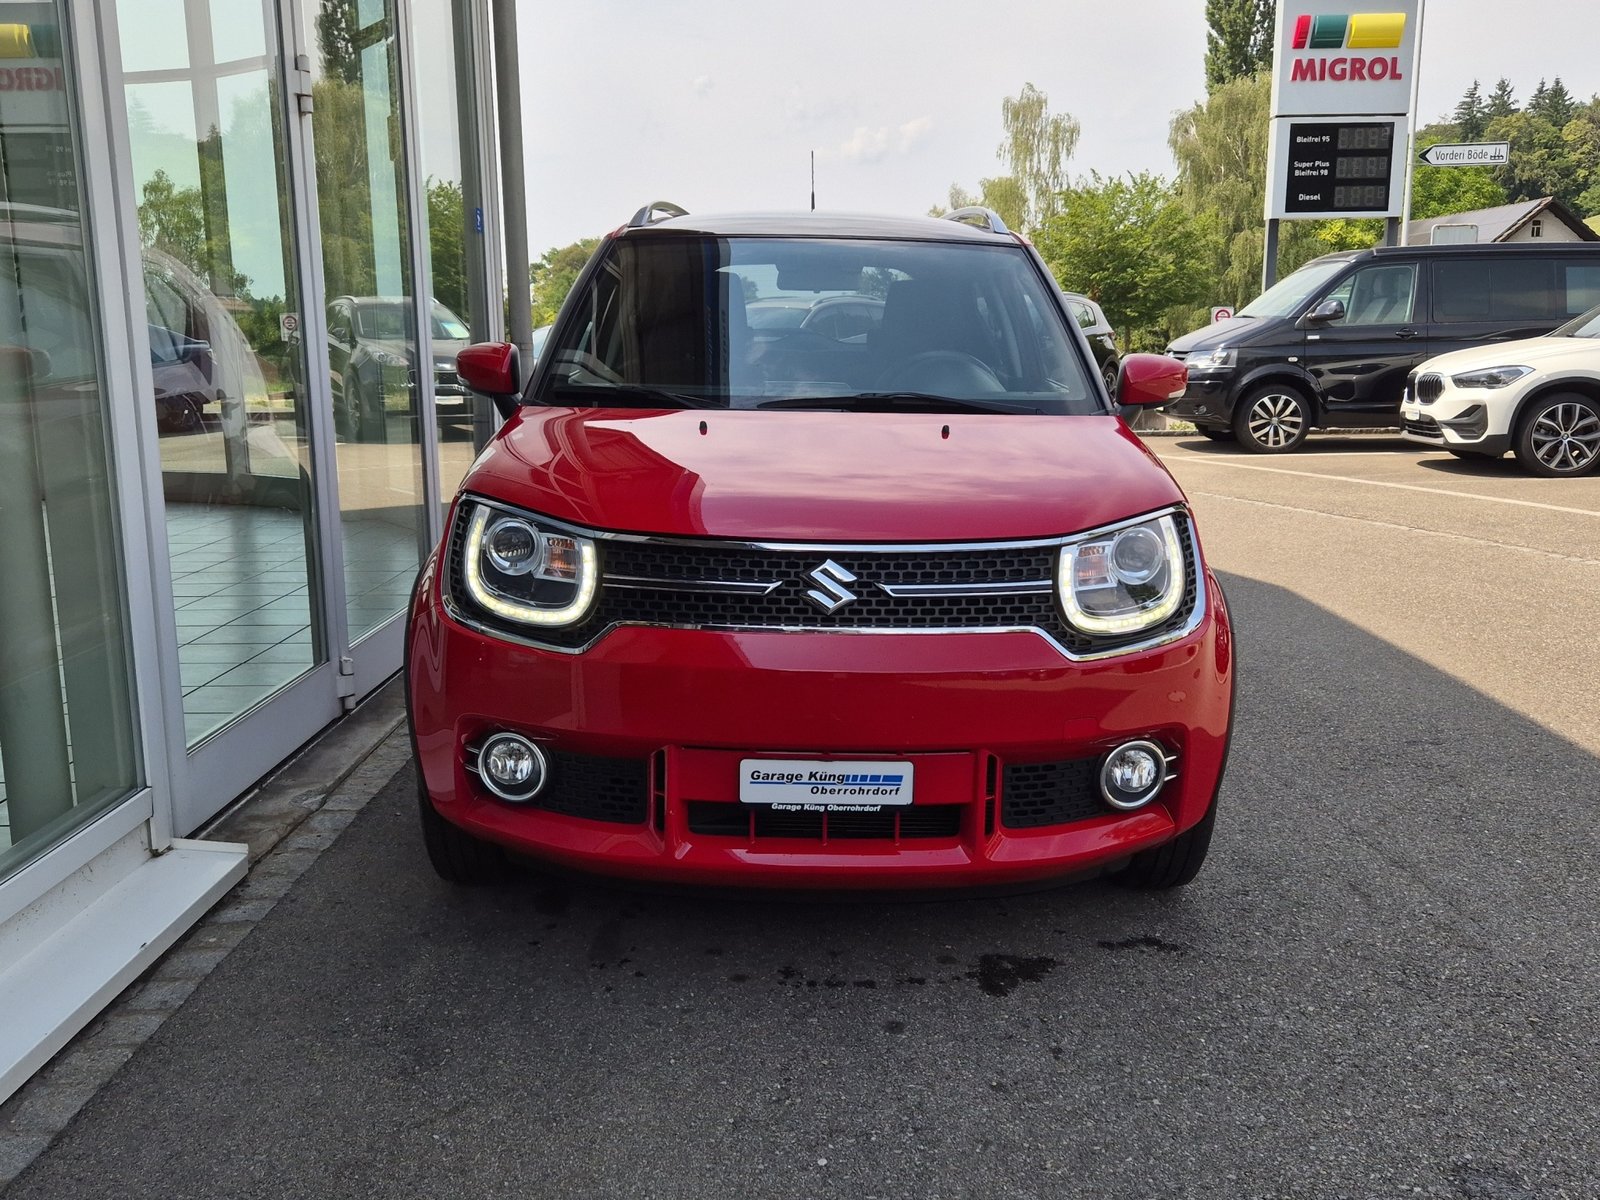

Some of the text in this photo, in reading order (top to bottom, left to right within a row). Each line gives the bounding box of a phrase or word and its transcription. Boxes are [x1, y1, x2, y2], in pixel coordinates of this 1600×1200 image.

[1291, 56, 1402, 81] MIGROL
[1322, 135, 1331, 143] 95
[1435, 148, 1489, 161] Vorderi Böde
[1298, 193, 1321, 201] Diesel
[750, 770, 846, 784] Garage Küng
[810, 786, 900, 796] Oberrohrdorf
[771, 803, 881, 812] Garage Küng Oberrohrdorf
